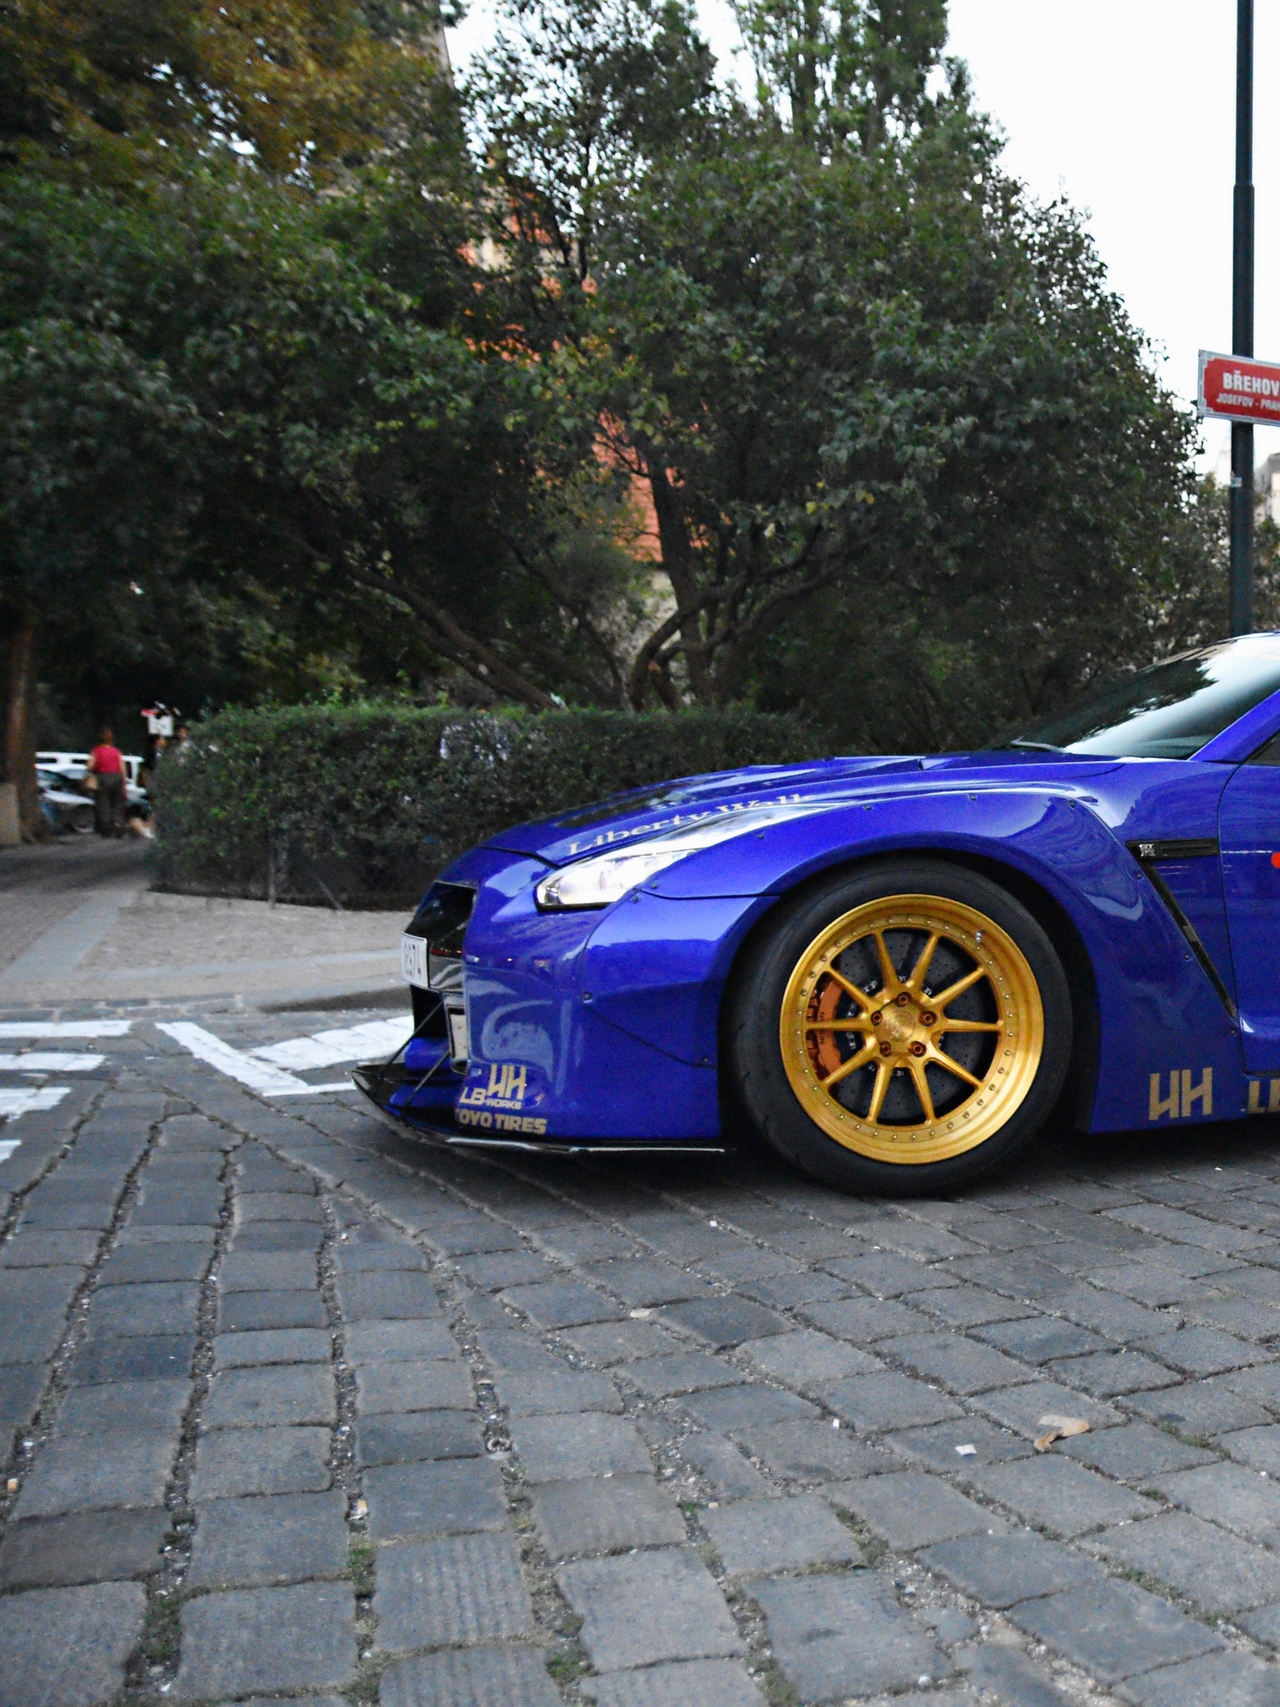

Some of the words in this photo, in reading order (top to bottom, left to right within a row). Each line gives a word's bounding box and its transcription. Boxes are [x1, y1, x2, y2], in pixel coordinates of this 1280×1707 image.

[1216, 393, 1254, 407] JOSEFOV
[567, 811, 711, 855] Liberty
[494, 1113, 548, 1134] TIRES
